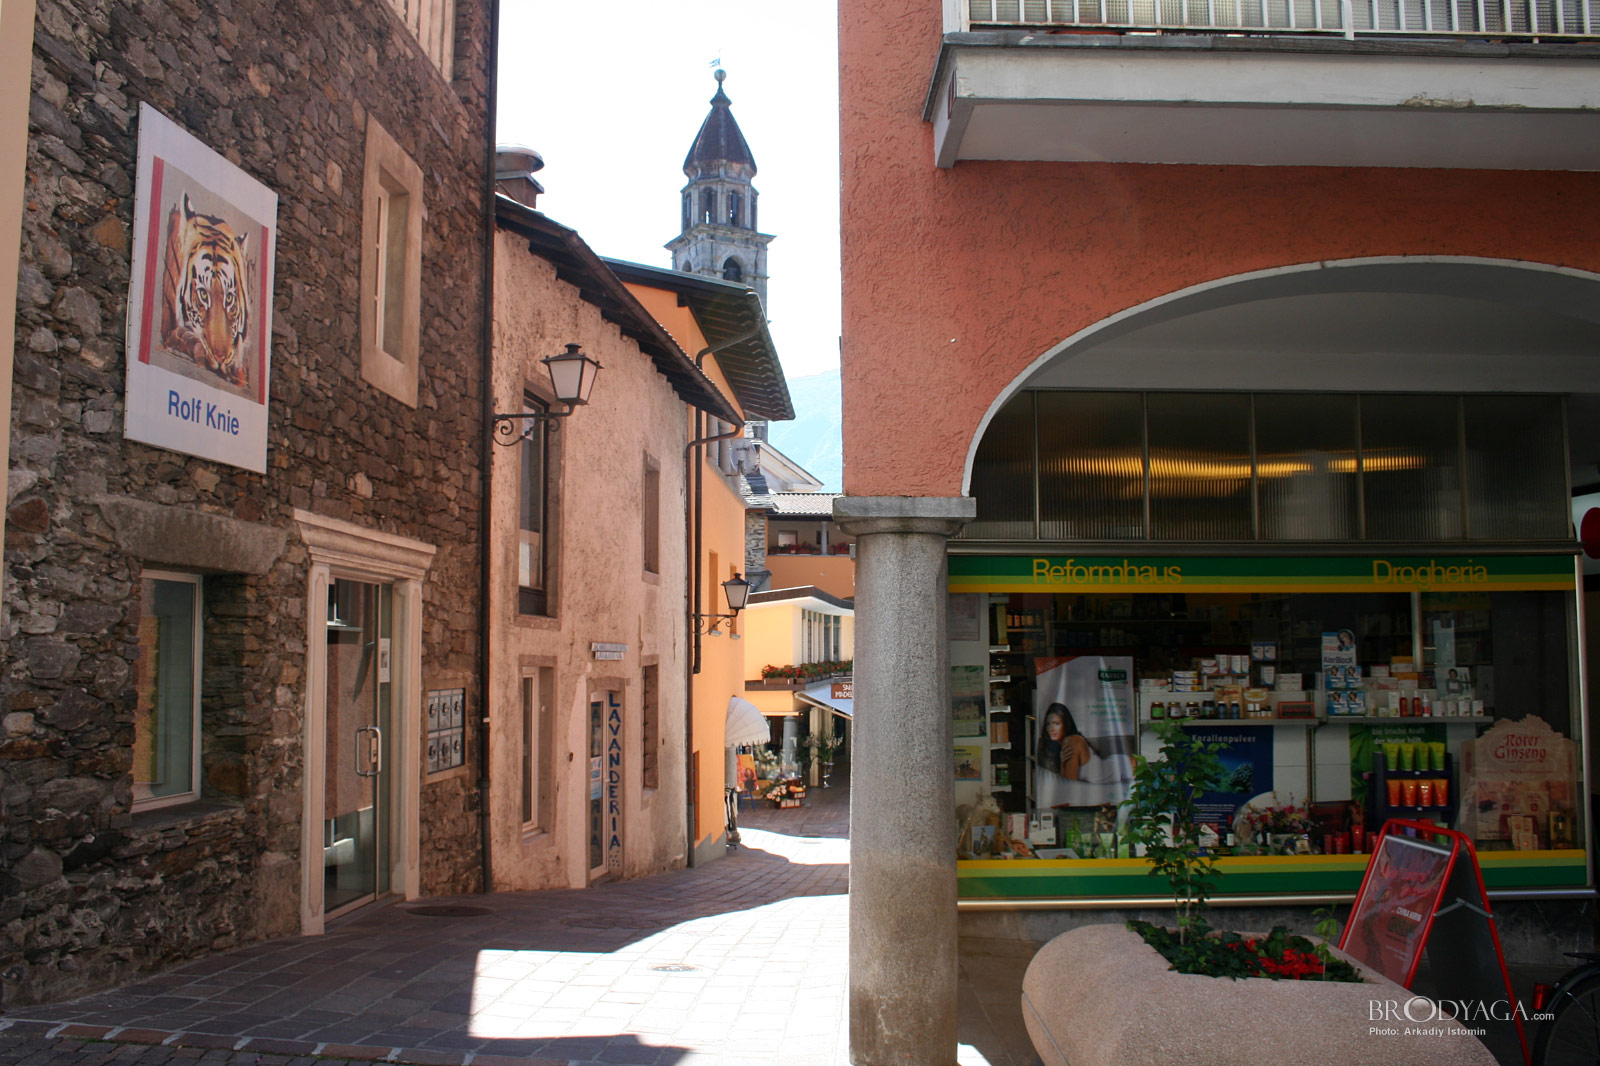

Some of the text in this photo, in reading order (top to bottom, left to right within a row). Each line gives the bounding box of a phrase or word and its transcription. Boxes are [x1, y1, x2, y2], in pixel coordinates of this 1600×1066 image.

[168, 389, 240, 436] Rolf Knie
[1032, 558, 1183, 584] Reformhaus
[1372, 559, 1488, 589] Drogheria
[1191, 733, 1257, 745] Korallenpulver
[1504, 733, 1540, 747] Roter
[1494, 746, 1547, 763] Ginseng
[608, 692, 622, 851] LAVANDERIA
